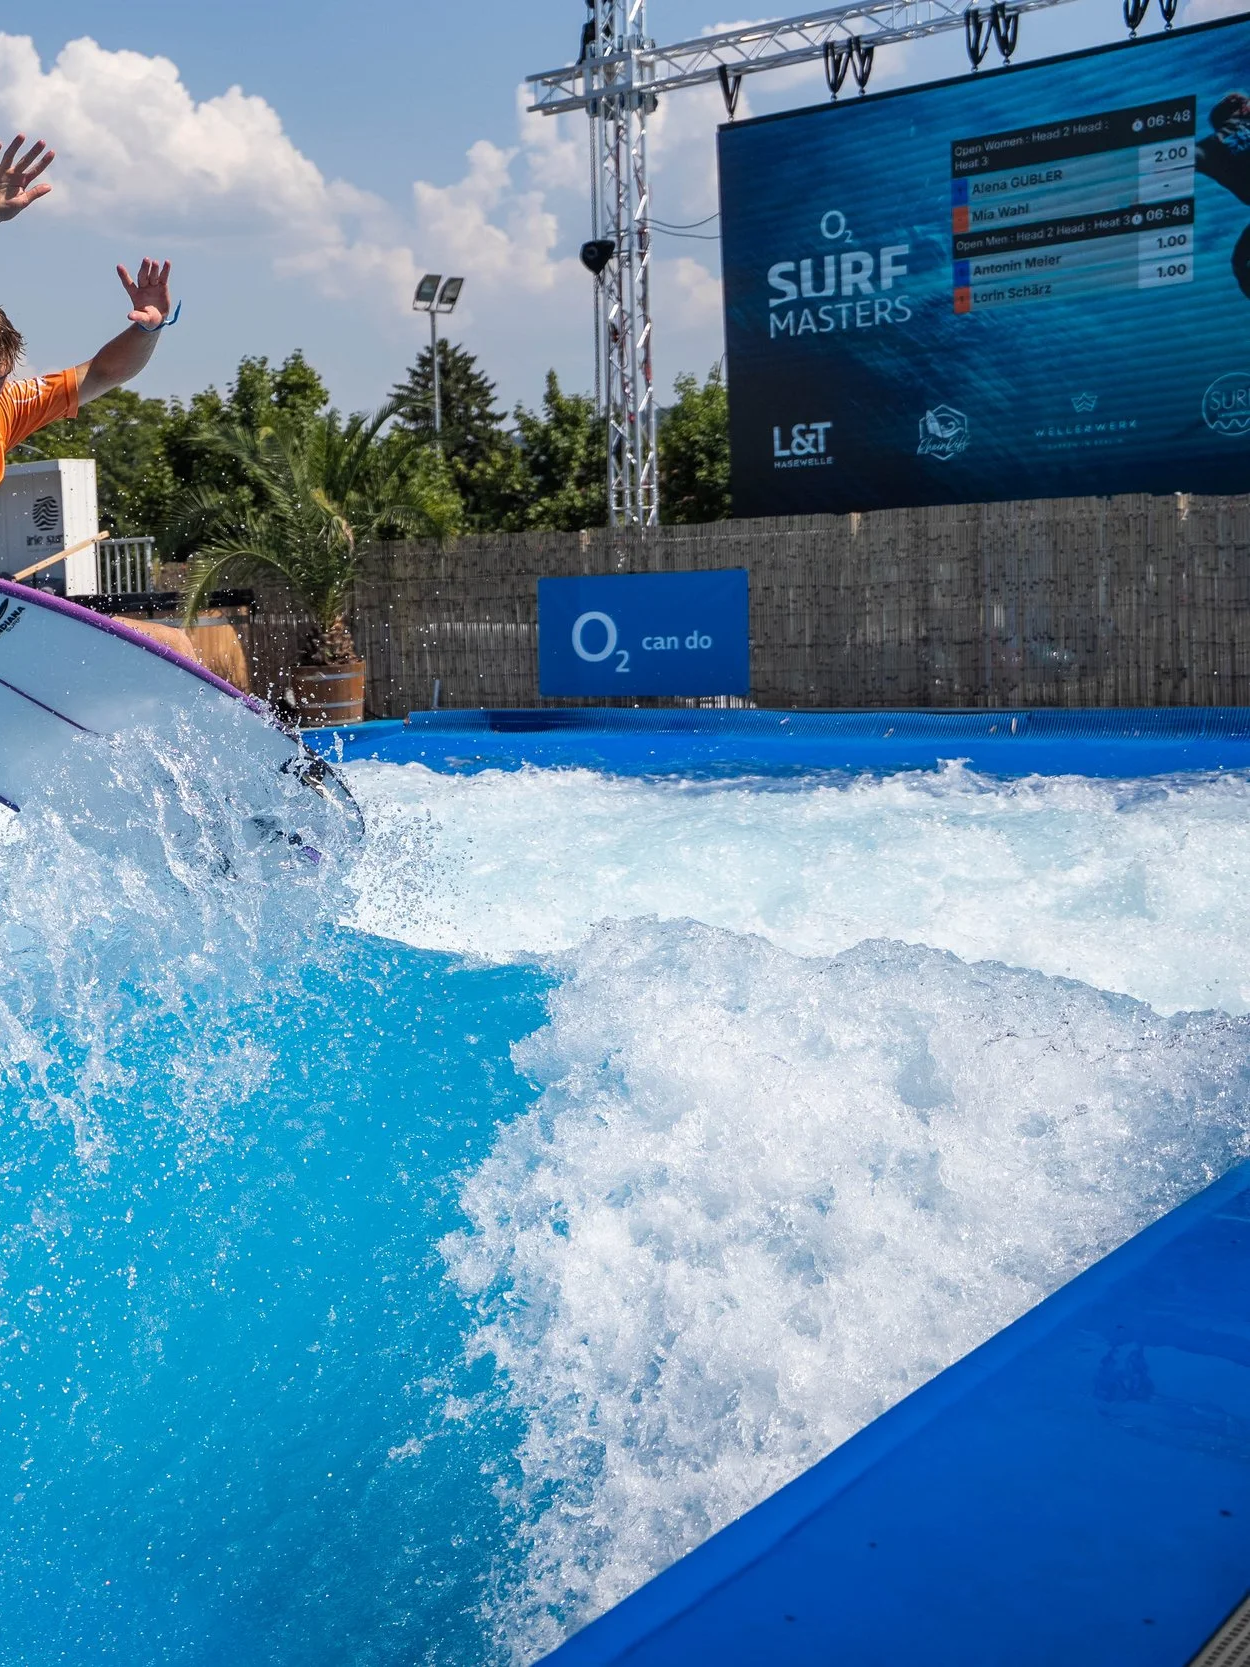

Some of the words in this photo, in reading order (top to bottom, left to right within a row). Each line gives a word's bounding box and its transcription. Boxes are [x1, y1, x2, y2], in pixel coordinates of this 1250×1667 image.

[954, 144, 982, 157] Open
[984, 136, 1023, 151] Women
[1031, 129, 1060, 143] Head
[1063, 127, 1070, 137] 2
[1073, 121, 1102, 135] Head
[954, 158, 979, 171] Heat
[981, 156, 989, 167] 3
[1154, 146, 1188, 163] 2.00
[972, 179, 1008, 195] Alena
[1010, 169, 1063, 188] GUBLER
[972, 204, 995, 222] Mia
[997, 202, 1029, 219] Wahl
[955, 237, 983, 252] Open
[985, 234, 1008, 247] Men
[1016, 228, 1044, 242] Head
[1047, 227, 1054, 238] 2
[1056, 222, 1085, 236] Head
[1094, 217, 1120, 230] Heat
[1123, 215, 1131, 226] 3
[1156, 233, 1187, 249] 1.00
[767, 244, 910, 308] SURF
[973, 260, 1022, 277] Antonin
[1024, 253, 1062, 270] Meier
[1156, 263, 1187, 278] 1.00
[973, 289, 1005, 304] Lorin
[1007, 283, 1052, 299] Schärz
[769, 295, 912, 339] MASTERS
[1210, 388, 1250, 411] SUR
[773, 421, 833, 457] L&T
[774, 456, 833, 469] HASEWELLE
[641, 636, 679, 651] can
[684, 630, 712, 650] do
